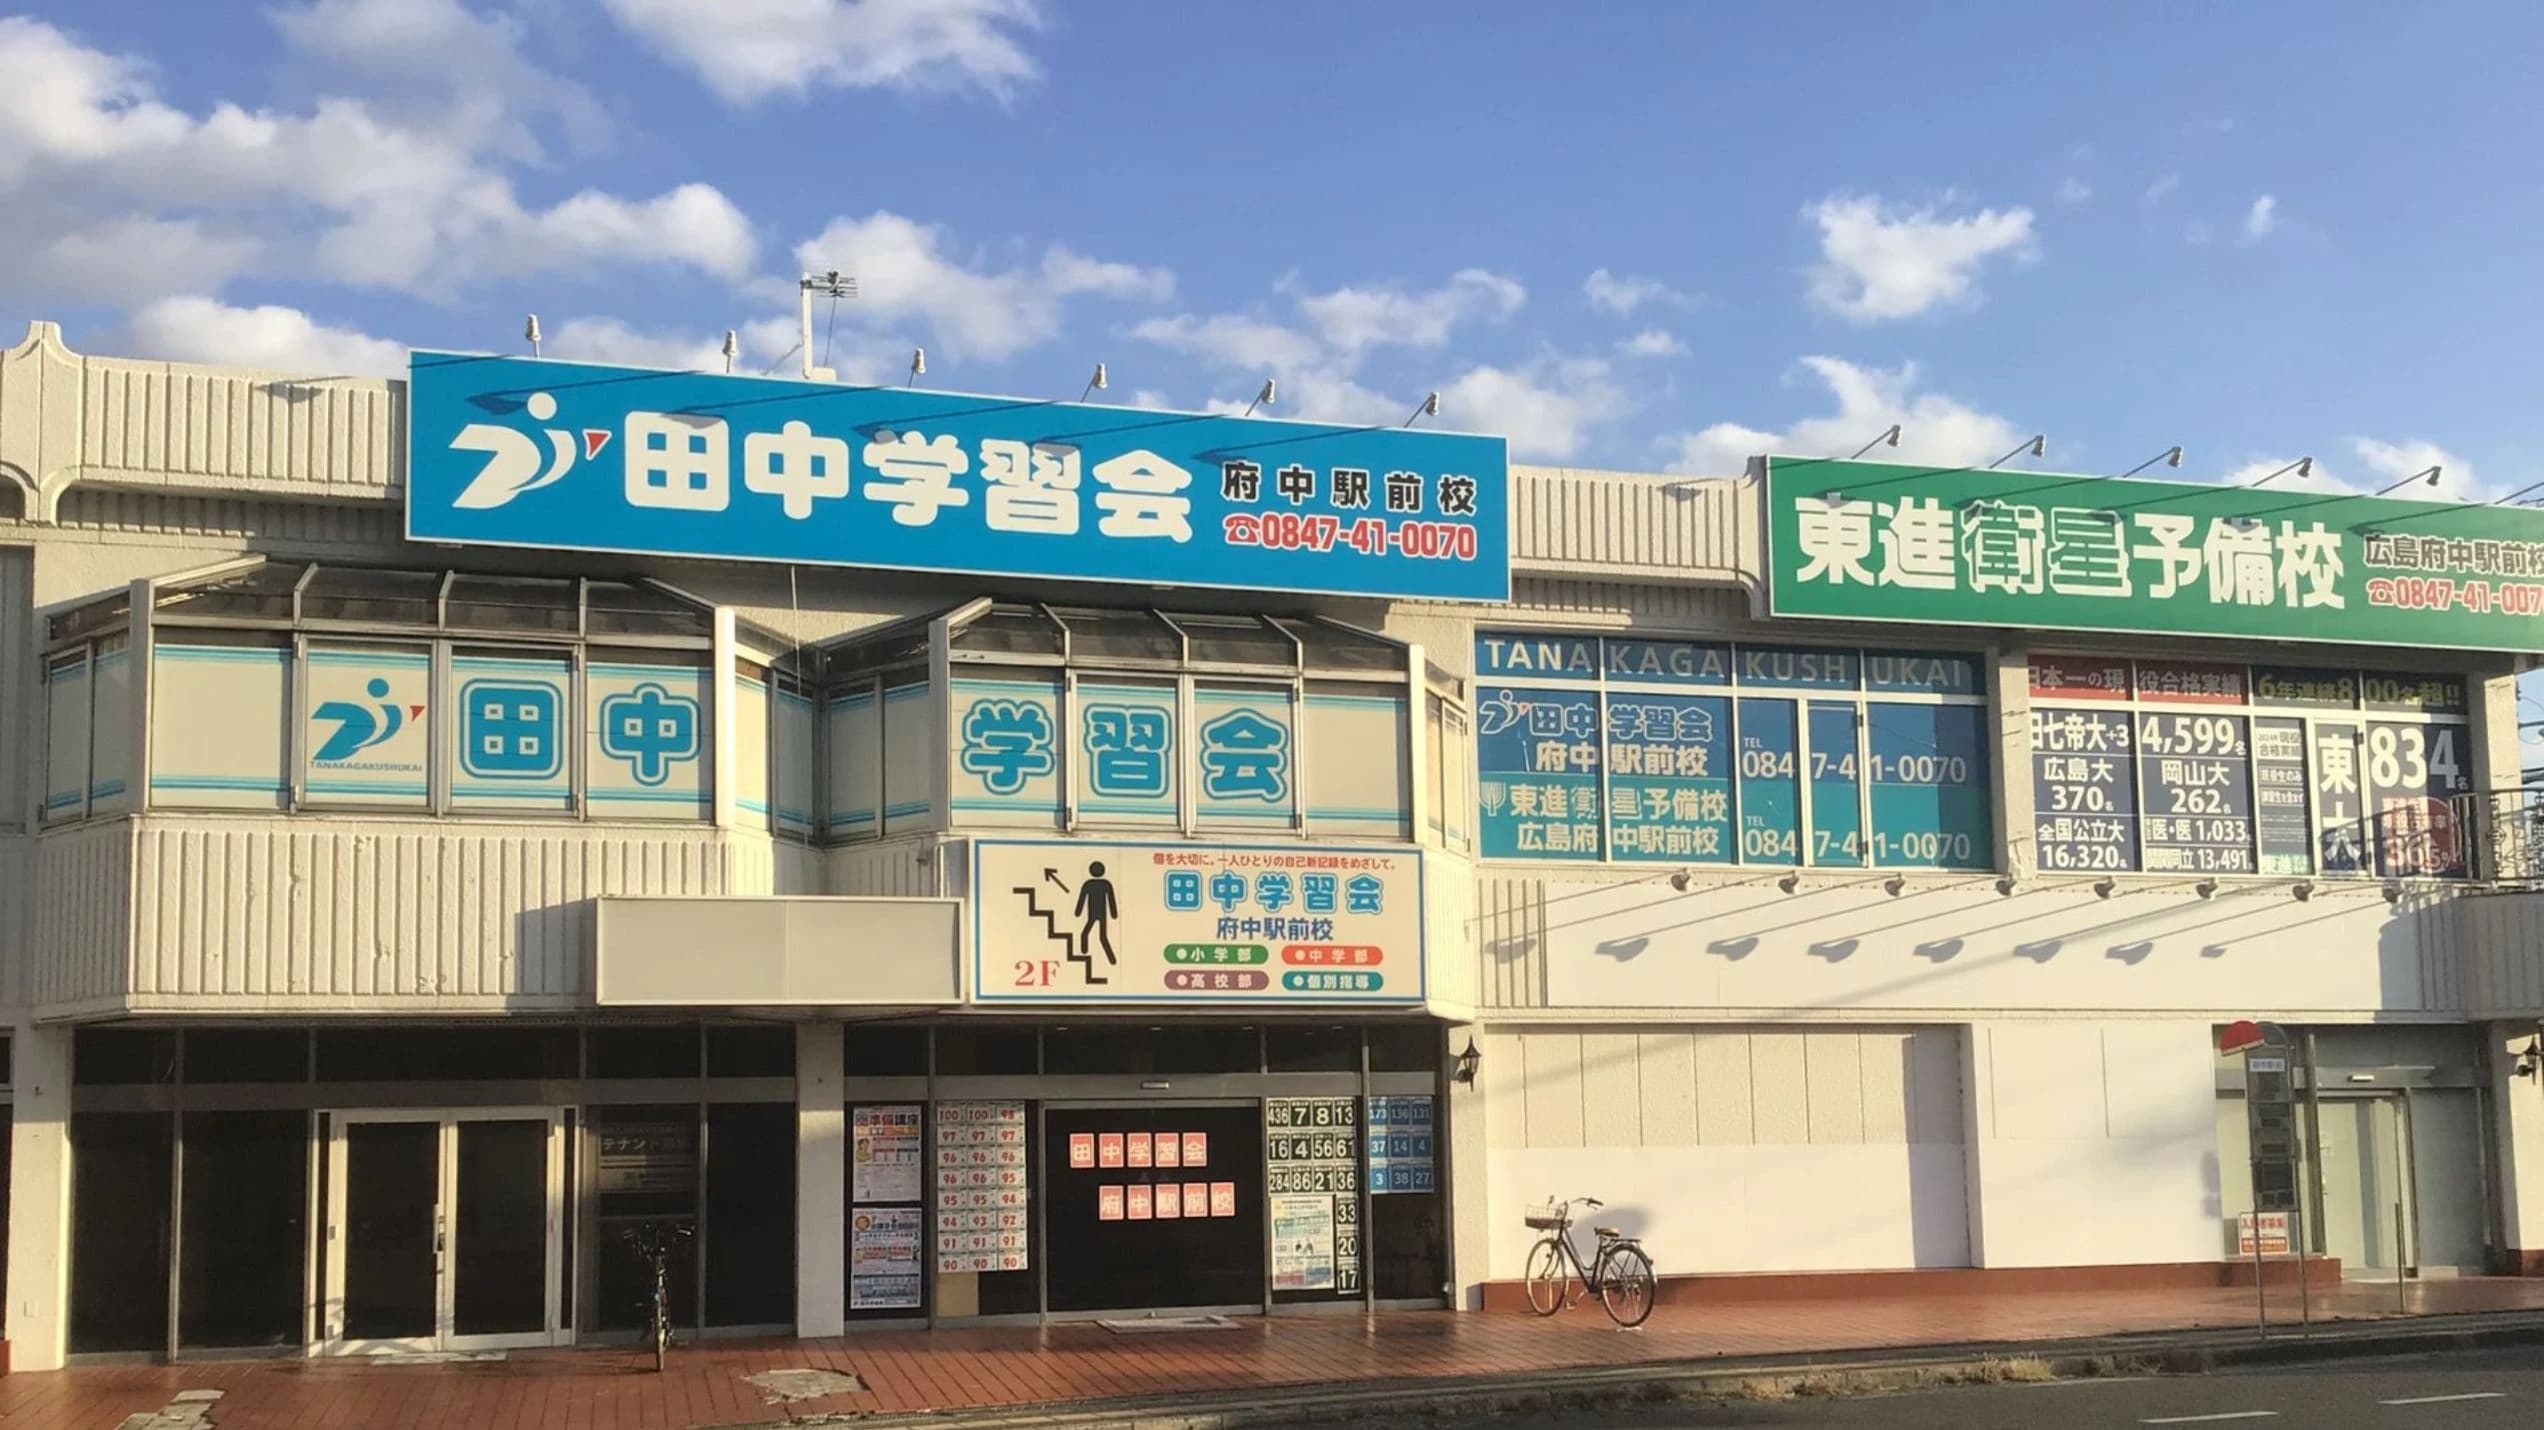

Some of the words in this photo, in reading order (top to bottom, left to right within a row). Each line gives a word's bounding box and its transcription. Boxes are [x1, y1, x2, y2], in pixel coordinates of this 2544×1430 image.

[624, 410, 1193, 543] 田中学習会
[1222, 461, 1477, 516] 府中駅前校
[1260, 512, 1477, 560] 0847-41-0070
[1795, 496, 2346, 610] 東進衛星予備校
[2364, 533, 2544, 577] 広島府中駅前校
[2395, 576, 2544, 617] 0847-41-007
[1744, 737, 1763, 748] TEL
[2044, 758, 2113, 782] 広島大
[2161, 760, 2230, 786] 岡山大
[1746, 815, 1765, 826] TEL
[2038, 818, 2124, 842] 全国公立大
[1164, 869, 1383, 915] 田中学習会
[1217, 917, 1334, 941] 府中駅前校
[1191, 947, 1252, 962] 小学部
[1308, 949, 1368, 963] 中学部
[1014, 959, 1060, 987] 2F
[1308, 974, 1370, 989] 個別指導
[940, 1110, 959, 1121] 100
[969, 1110, 988, 1121] 100
[1294, 1108, 1307, 1124] 7
[1316, 1108, 1330, 1124] 8
[1336, 1107, 1353, 1123] 13
[1270, 1141, 1287, 1157] 16
[1295, 1141, 1308, 1158] 4
[1314, 1140, 1332, 1157] 56
[1293, 1173, 1311, 1190] 86
[1314, 1173, 1333, 1190] 21
[1338, 1173, 1355, 1190] 36
[1375, 1172, 1385, 1185] 3
[1338, 1204, 1356, 1222] 33
[1339, 1237, 1357, 1255] 20
[1340, 1270, 1357, 1288] 17
